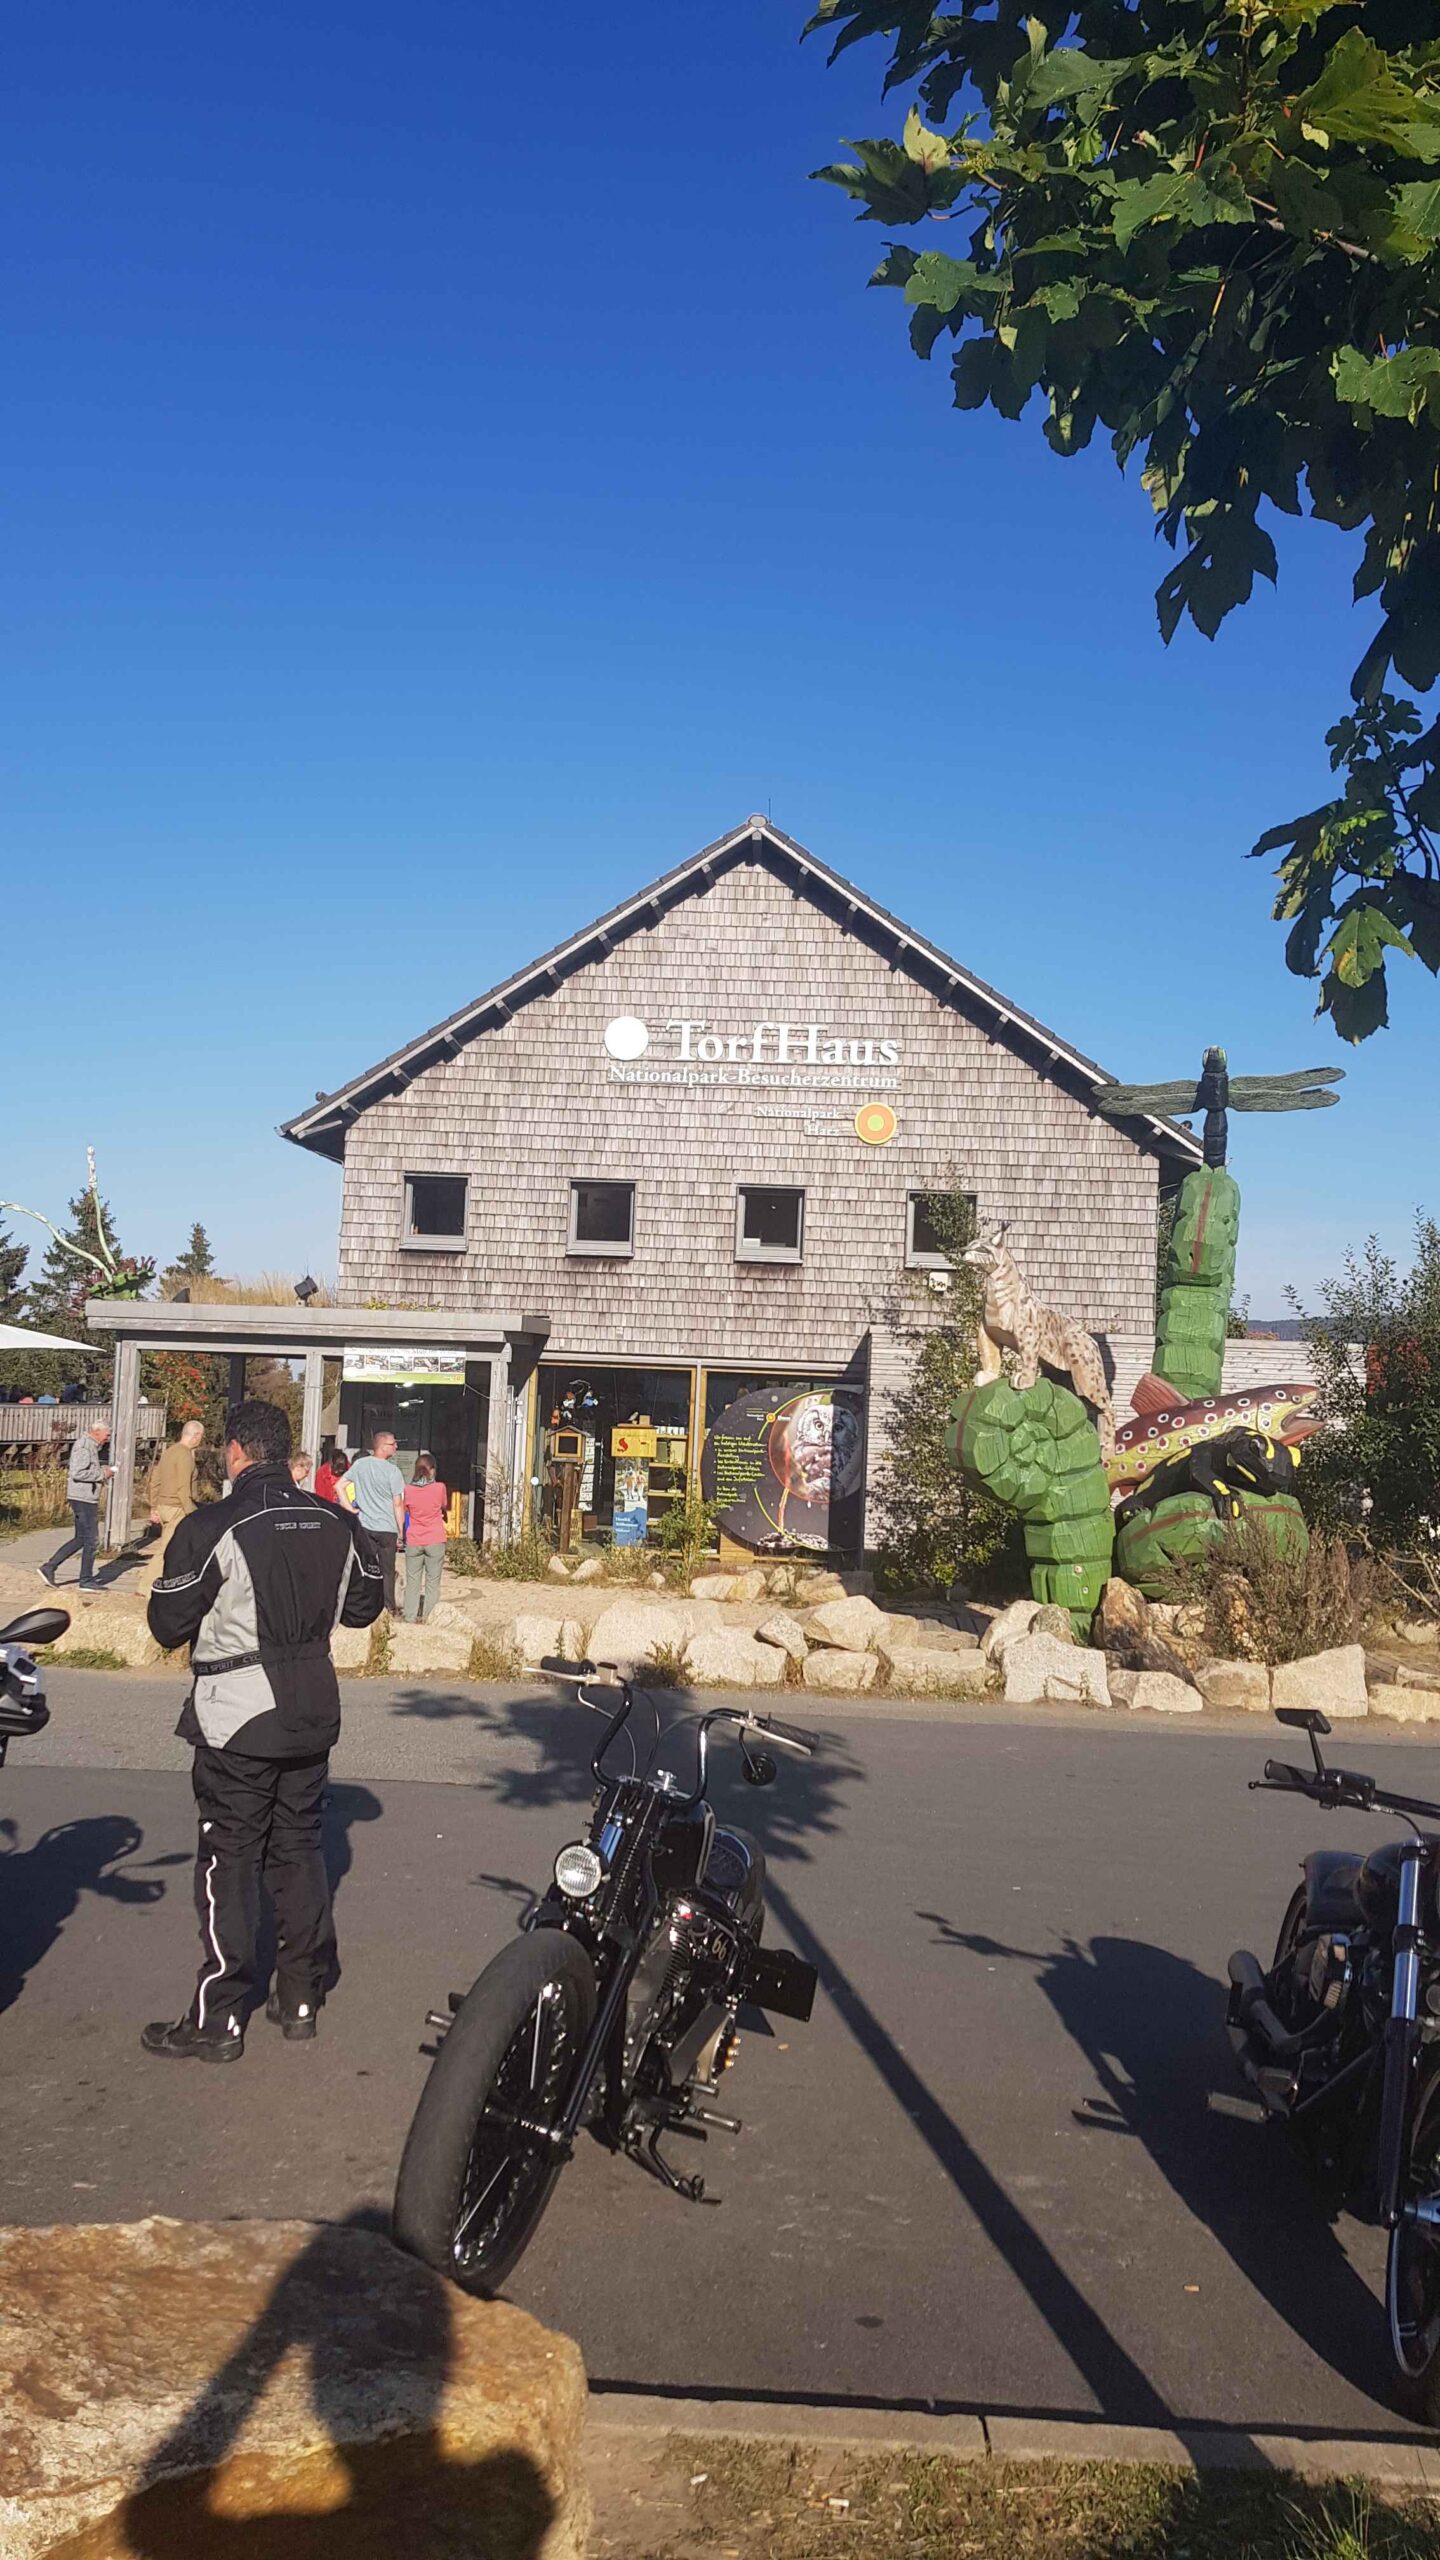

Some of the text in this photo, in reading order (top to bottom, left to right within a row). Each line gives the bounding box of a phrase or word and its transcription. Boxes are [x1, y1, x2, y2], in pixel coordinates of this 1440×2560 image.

[666, 1019, 900, 1066] TorfHaus
[609, 1066, 898, 1089] Nationalpark-Besucherzentrum
[756, 1106, 839, 1121] Nationalpark
[210, 1660, 234, 1672] SPIRIT
[711, 1932, 730, 1961] 66
